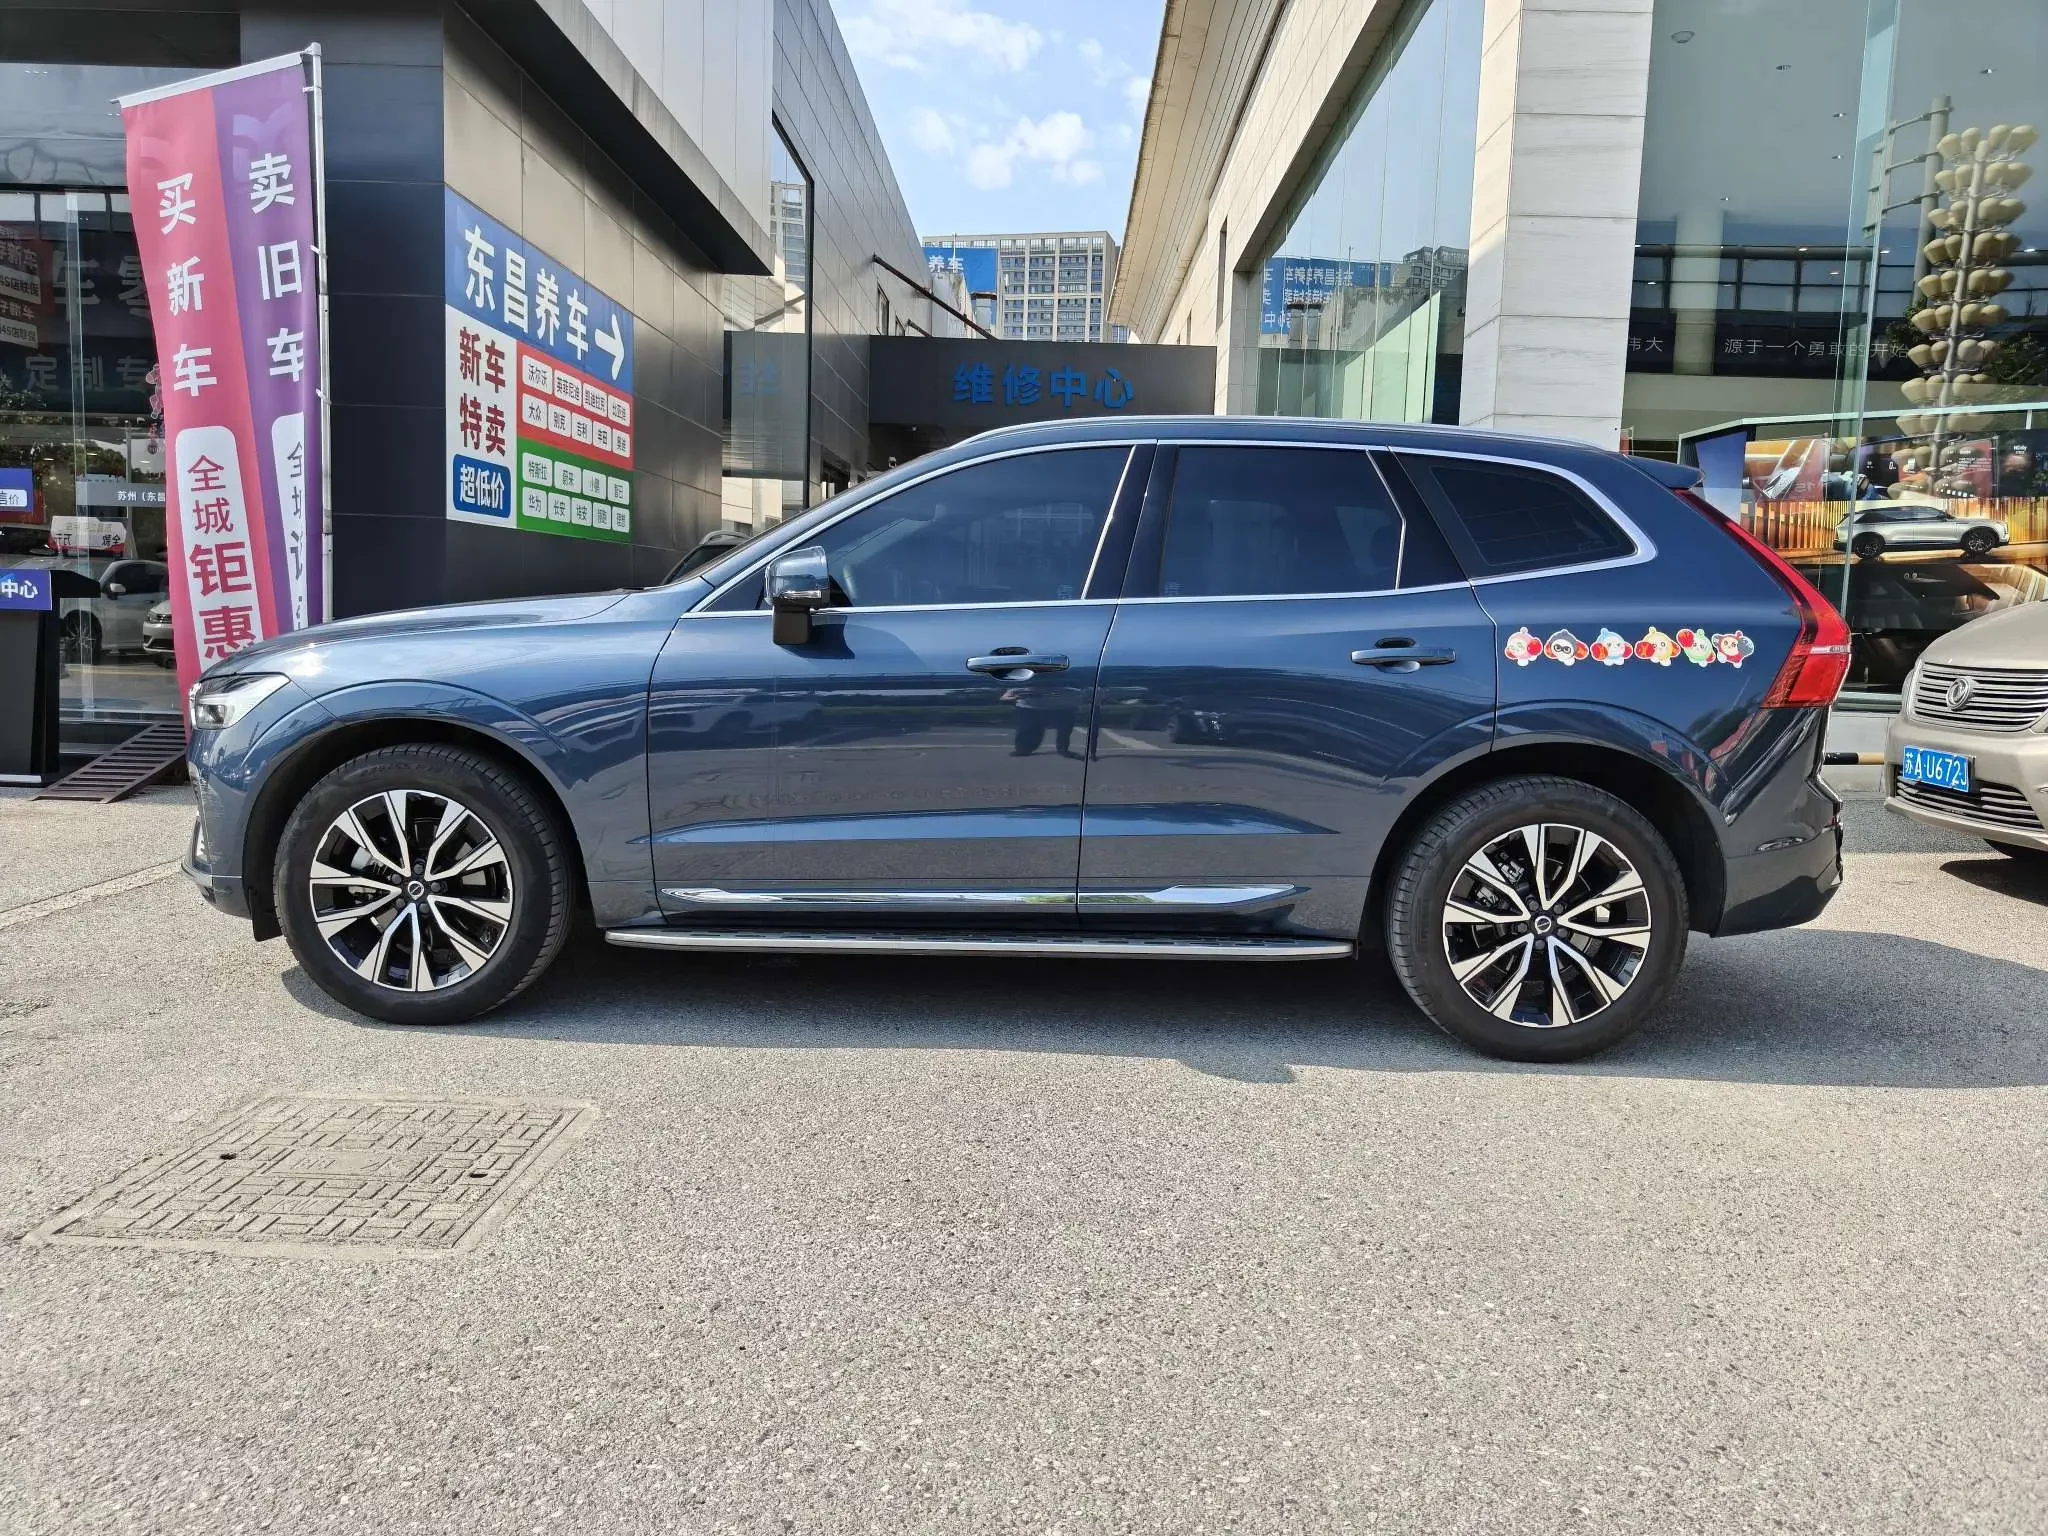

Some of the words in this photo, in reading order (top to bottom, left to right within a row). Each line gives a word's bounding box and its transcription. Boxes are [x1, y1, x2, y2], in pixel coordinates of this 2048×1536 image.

[157, 172, 218, 397] 买新车
[249, 152, 304, 384] 卖旧车
[928, 255, 964, 274] 养车
[464, 223, 589, 361] 东昌养车
[458, 325, 507, 395] 新车
[1724, 338, 1909, 360] 源于一个勇敢的开始
[952, 361, 1136, 410] 维修中心
[459, 391, 507, 459] 特卖
[528, 402, 542, 422] 大众
[459, 463, 506, 511] 超低价
[528, 494, 542, 513] 华为
[187, 454, 257, 659] 全城钜惠
[1, 578, 39, 599] 中心
